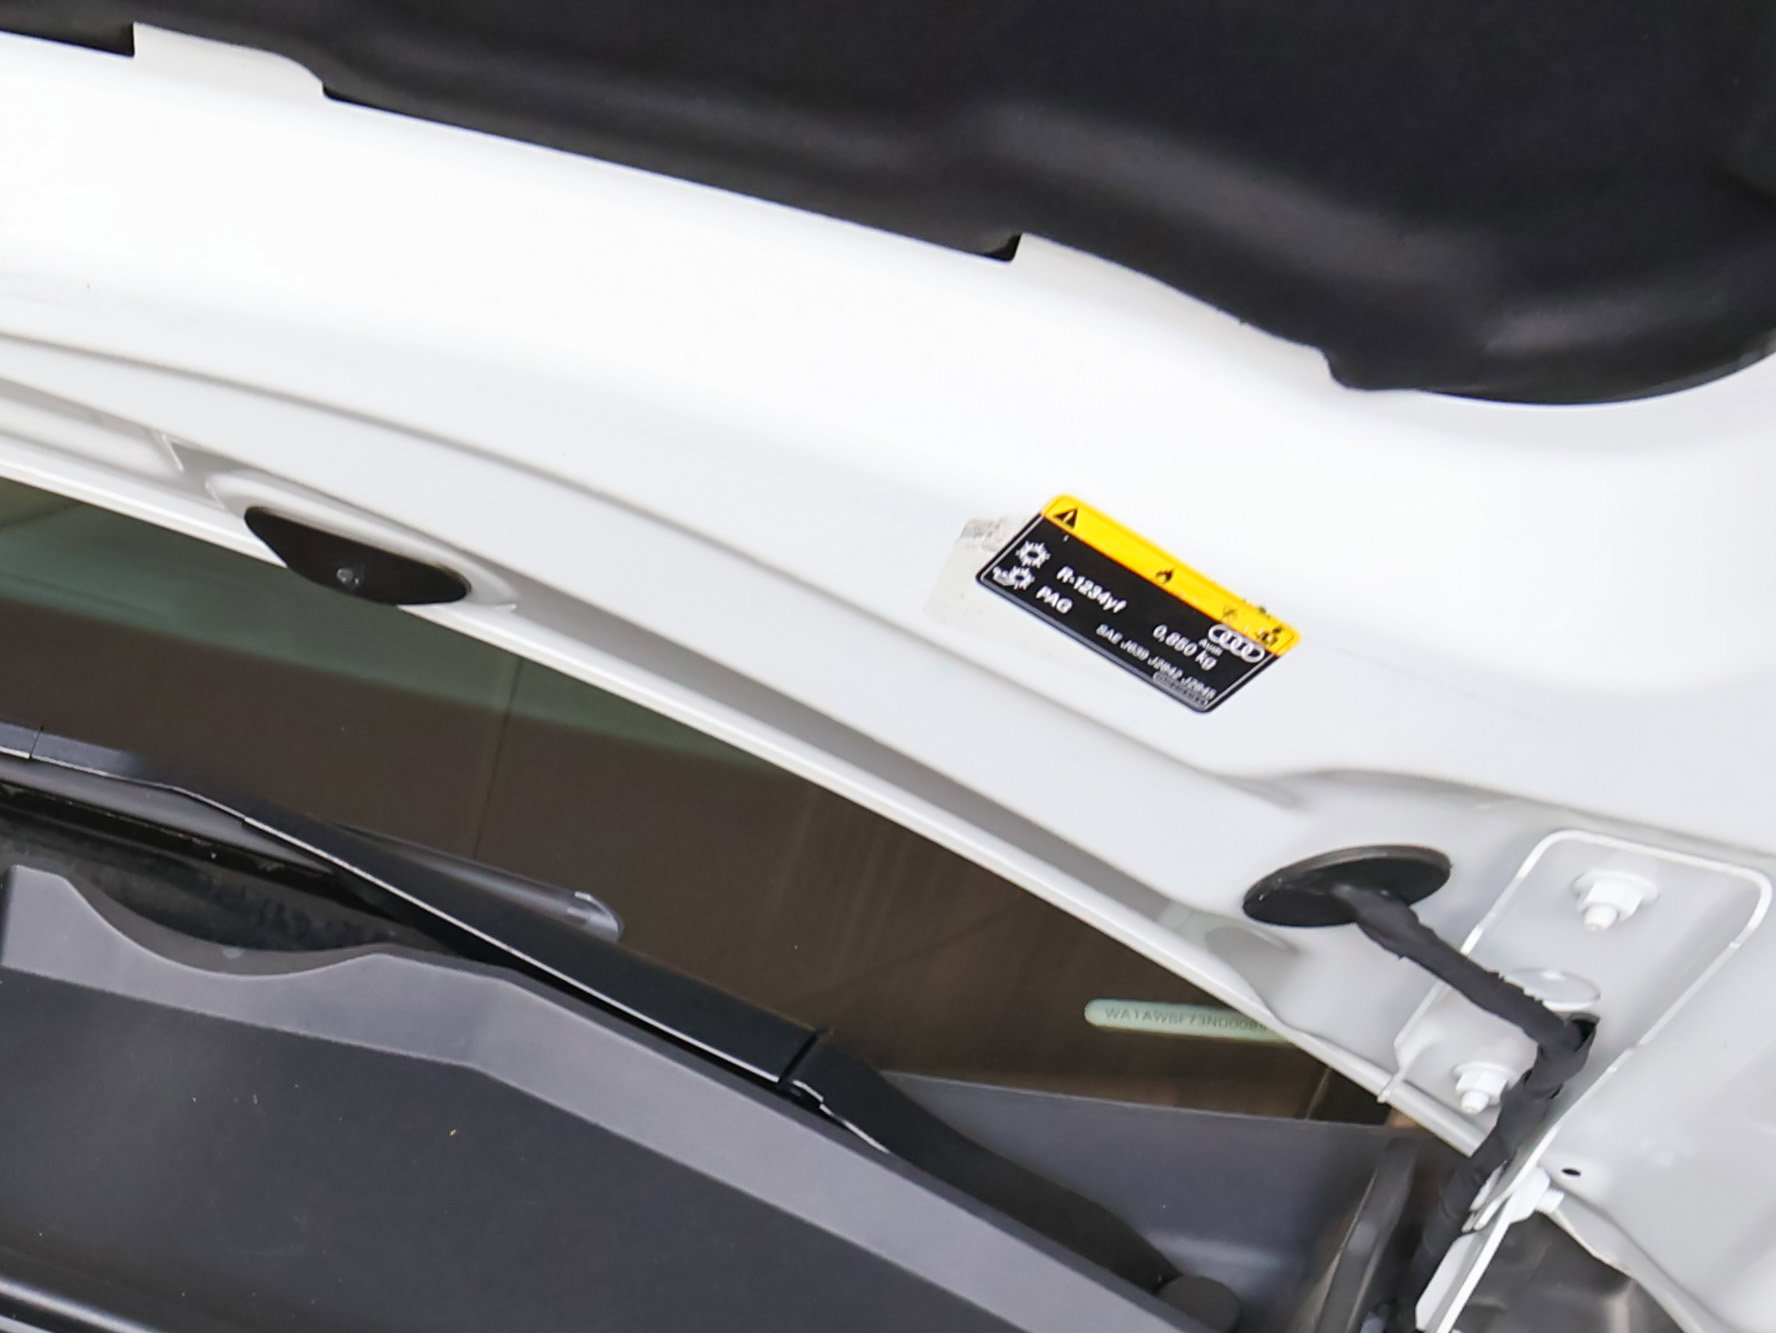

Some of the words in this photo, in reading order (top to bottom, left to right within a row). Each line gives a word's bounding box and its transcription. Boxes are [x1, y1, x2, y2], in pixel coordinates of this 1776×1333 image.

[1035, 586, 1073, 612] PAG
[1054, 567, 1125, 613] R-1234yf
[1095, 624, 1122, 642] SAE
[1193, 652, 1219, 669] kg
